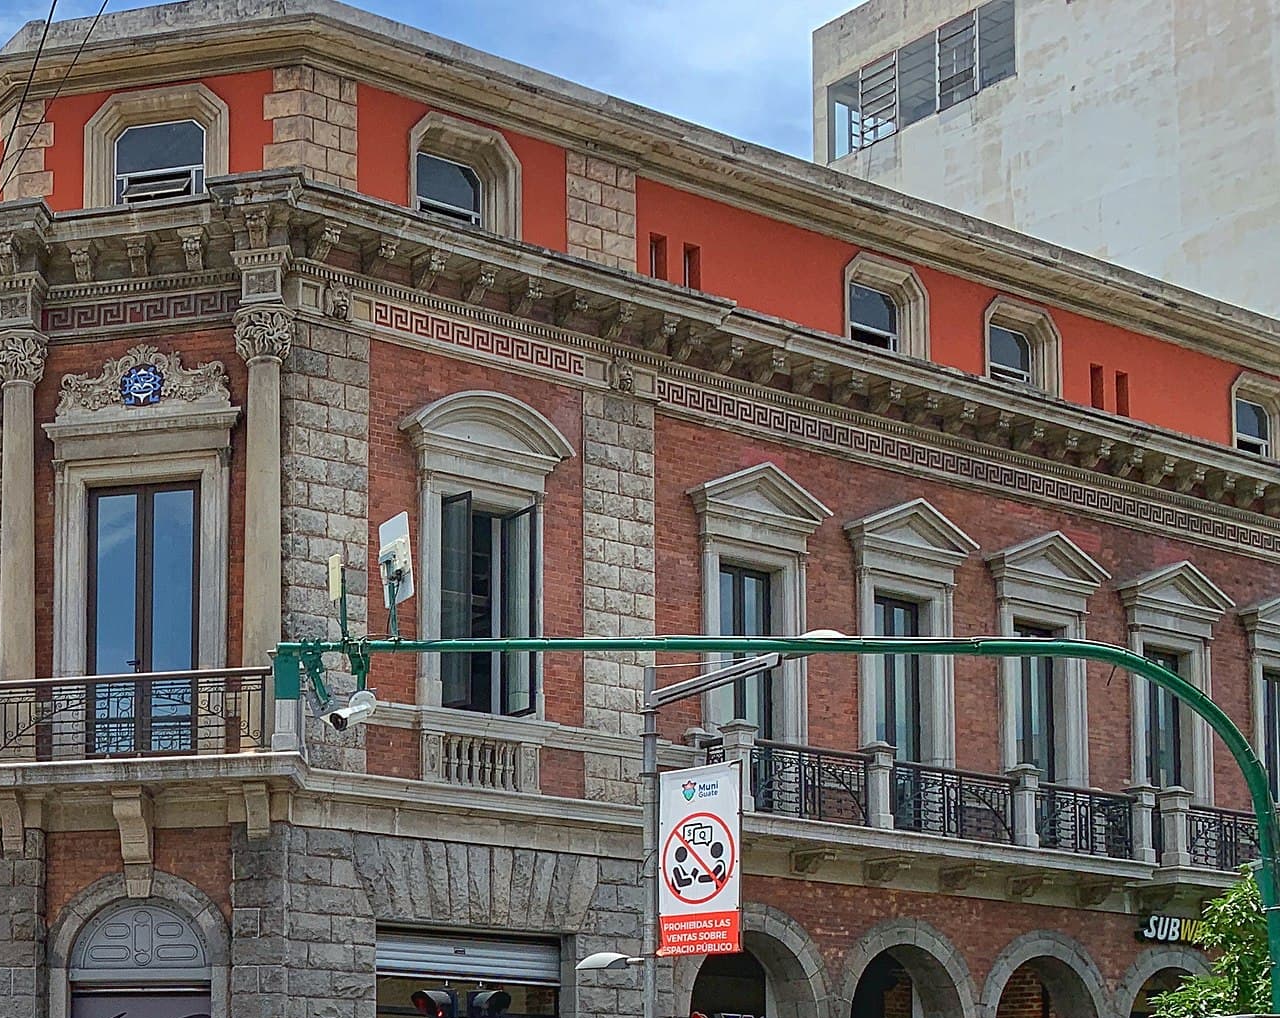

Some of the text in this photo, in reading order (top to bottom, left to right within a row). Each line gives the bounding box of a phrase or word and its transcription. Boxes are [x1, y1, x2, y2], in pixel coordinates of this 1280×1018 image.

[699, 780, 719, 791] Muni
[698, 790, 719, 798] Guate
[699, 830, 706, 841] Q
[663, 918, 731, 931] PROHIBIDAS LAS
[666, 931, 728, 943] VENTAS SOBRE
[696, 942, 733, 952] PÚBLICO
